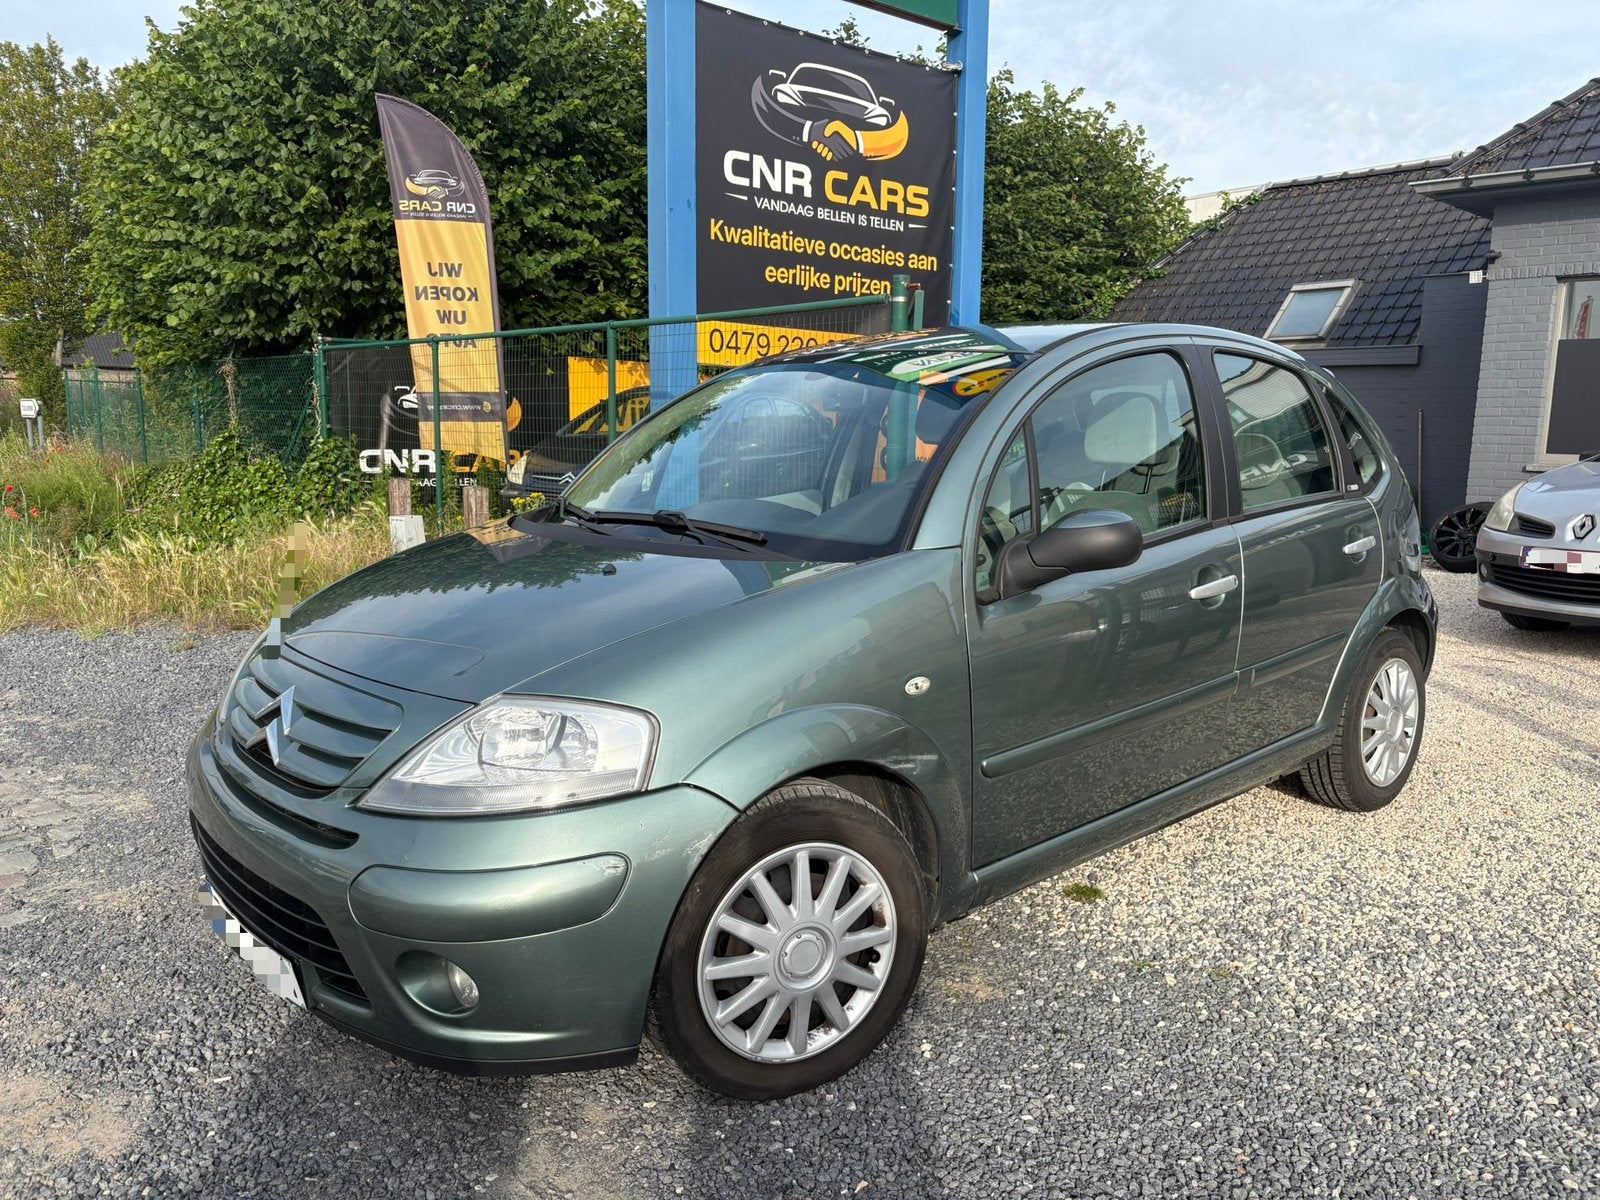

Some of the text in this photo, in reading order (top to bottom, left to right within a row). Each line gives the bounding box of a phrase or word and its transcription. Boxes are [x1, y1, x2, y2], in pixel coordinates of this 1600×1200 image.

[723, 149, 930, 218] CNR CARS
[754, 196, 904, 232] VANDAAG BELLEN IS TELLEN
[710, 218, 937, 271] Kwalitatieve occasies aan
[765, 264, 891, 297] eerlijke prijzen
[709, 328, 771, 357] 0479
[358, 449, 437, 474] CNR
